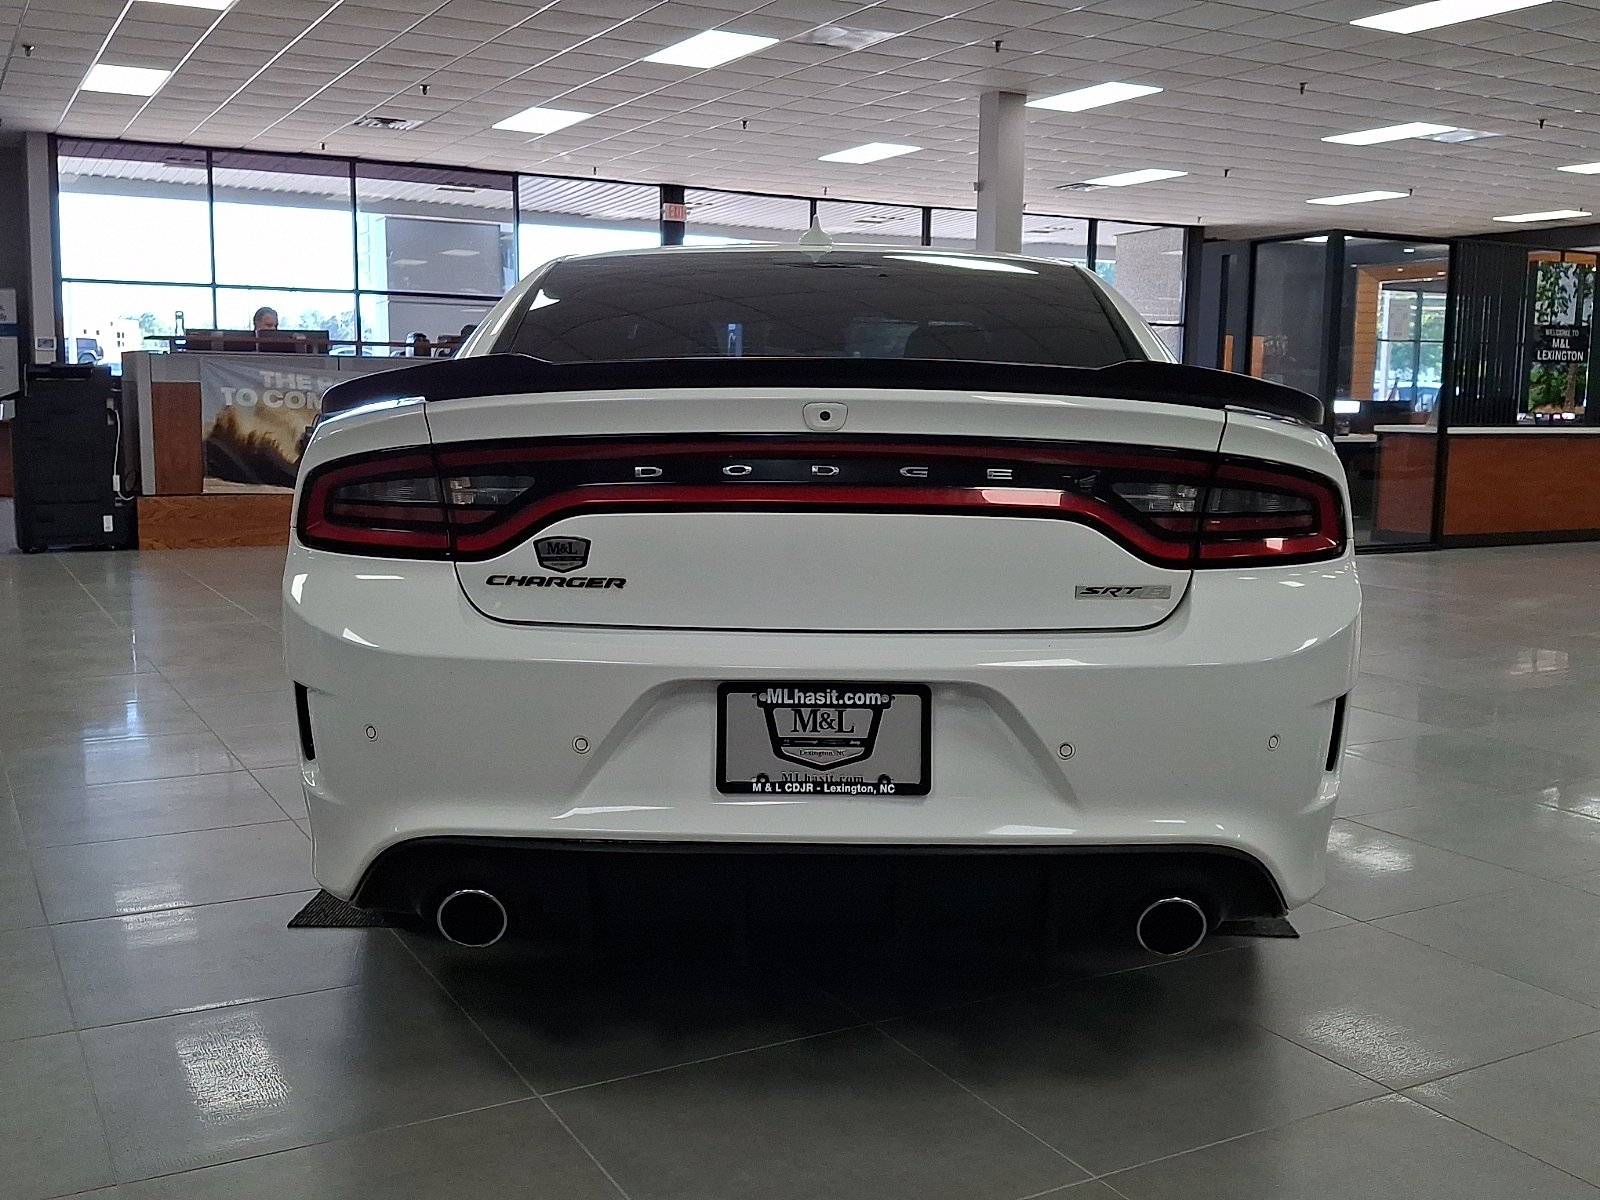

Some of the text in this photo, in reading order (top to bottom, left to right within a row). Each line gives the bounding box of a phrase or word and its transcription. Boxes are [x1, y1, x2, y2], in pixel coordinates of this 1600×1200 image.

[1552, 338, 1570, 348] M&L
[1537, 350, 1583, 361] LEXINGTON
[260, 371, 312, 390] THE
[221, 387, 258, 407] TO
[634, 464, 1013, 480] DODGE
[546, 541, 578, 555] M&L
[485, 574, 627, 589] CHARGER
[766, 688, 882, 705] MLhasit.com
[790, 708, 855, 734] M&L
[752, 783, 762, 792] M
[764, 783, 773, 793] &
[775, 784, 782, 793] L
[784, 784, 814, 793] CDJR
[823, 784, 877, 795] Lexington,
[879, 784, 896, 794] NC
